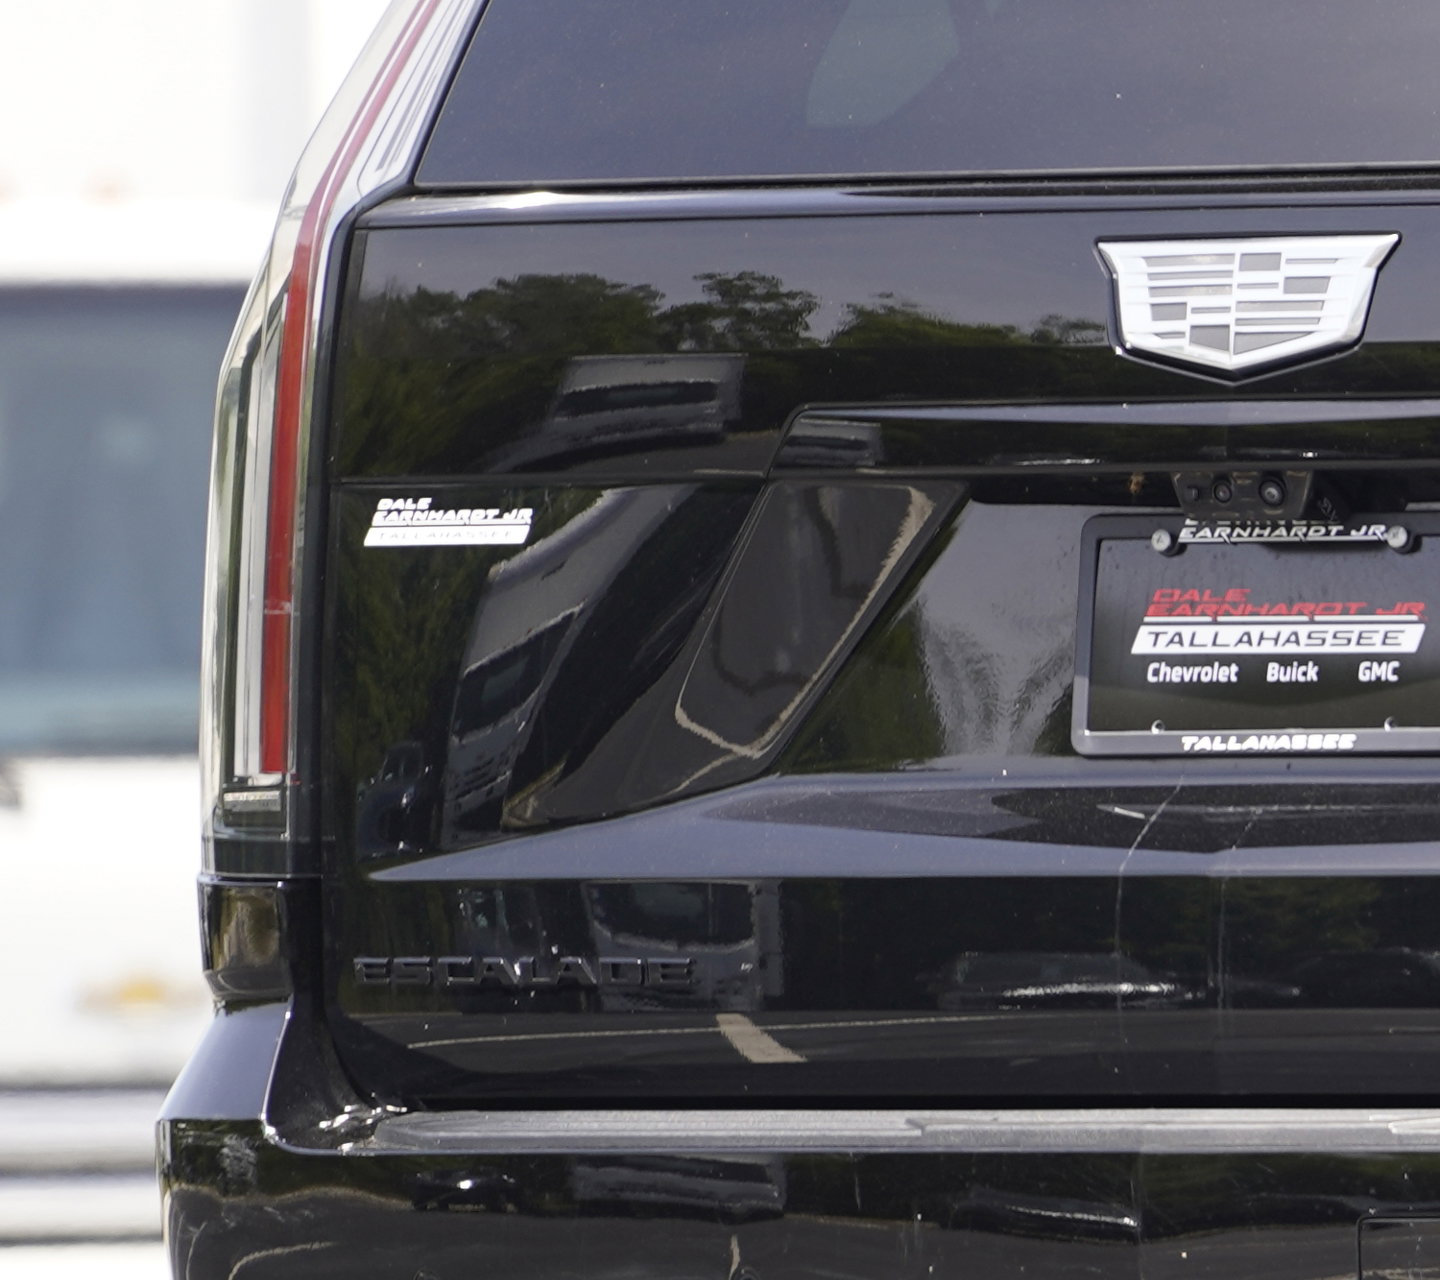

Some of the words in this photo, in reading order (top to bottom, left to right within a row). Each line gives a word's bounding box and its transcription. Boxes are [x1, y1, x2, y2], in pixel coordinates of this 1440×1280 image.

[376, 497, 433, 510] DALE
[371, 508, 500, 526] EARNHARDT
[1178, 525, 1344, 543] EARNHARDT
[1152, 588, 1251, 602] DALE
[1144, 602, 1367, 618] EARNHARDT
[1375, 602, 1426, 618] JR
[1147, 630, 1406, 648] TALLAHASSEE
[1146, 661, 1239, 683] Chevrolet
[1265, 660, 1319, 683] Buick
[1357, 660, 1400, 682] GMC
[1181, 733, 1357, 752] TALLAHASSEE
[352, 956, 698, 985] ESCALADE
